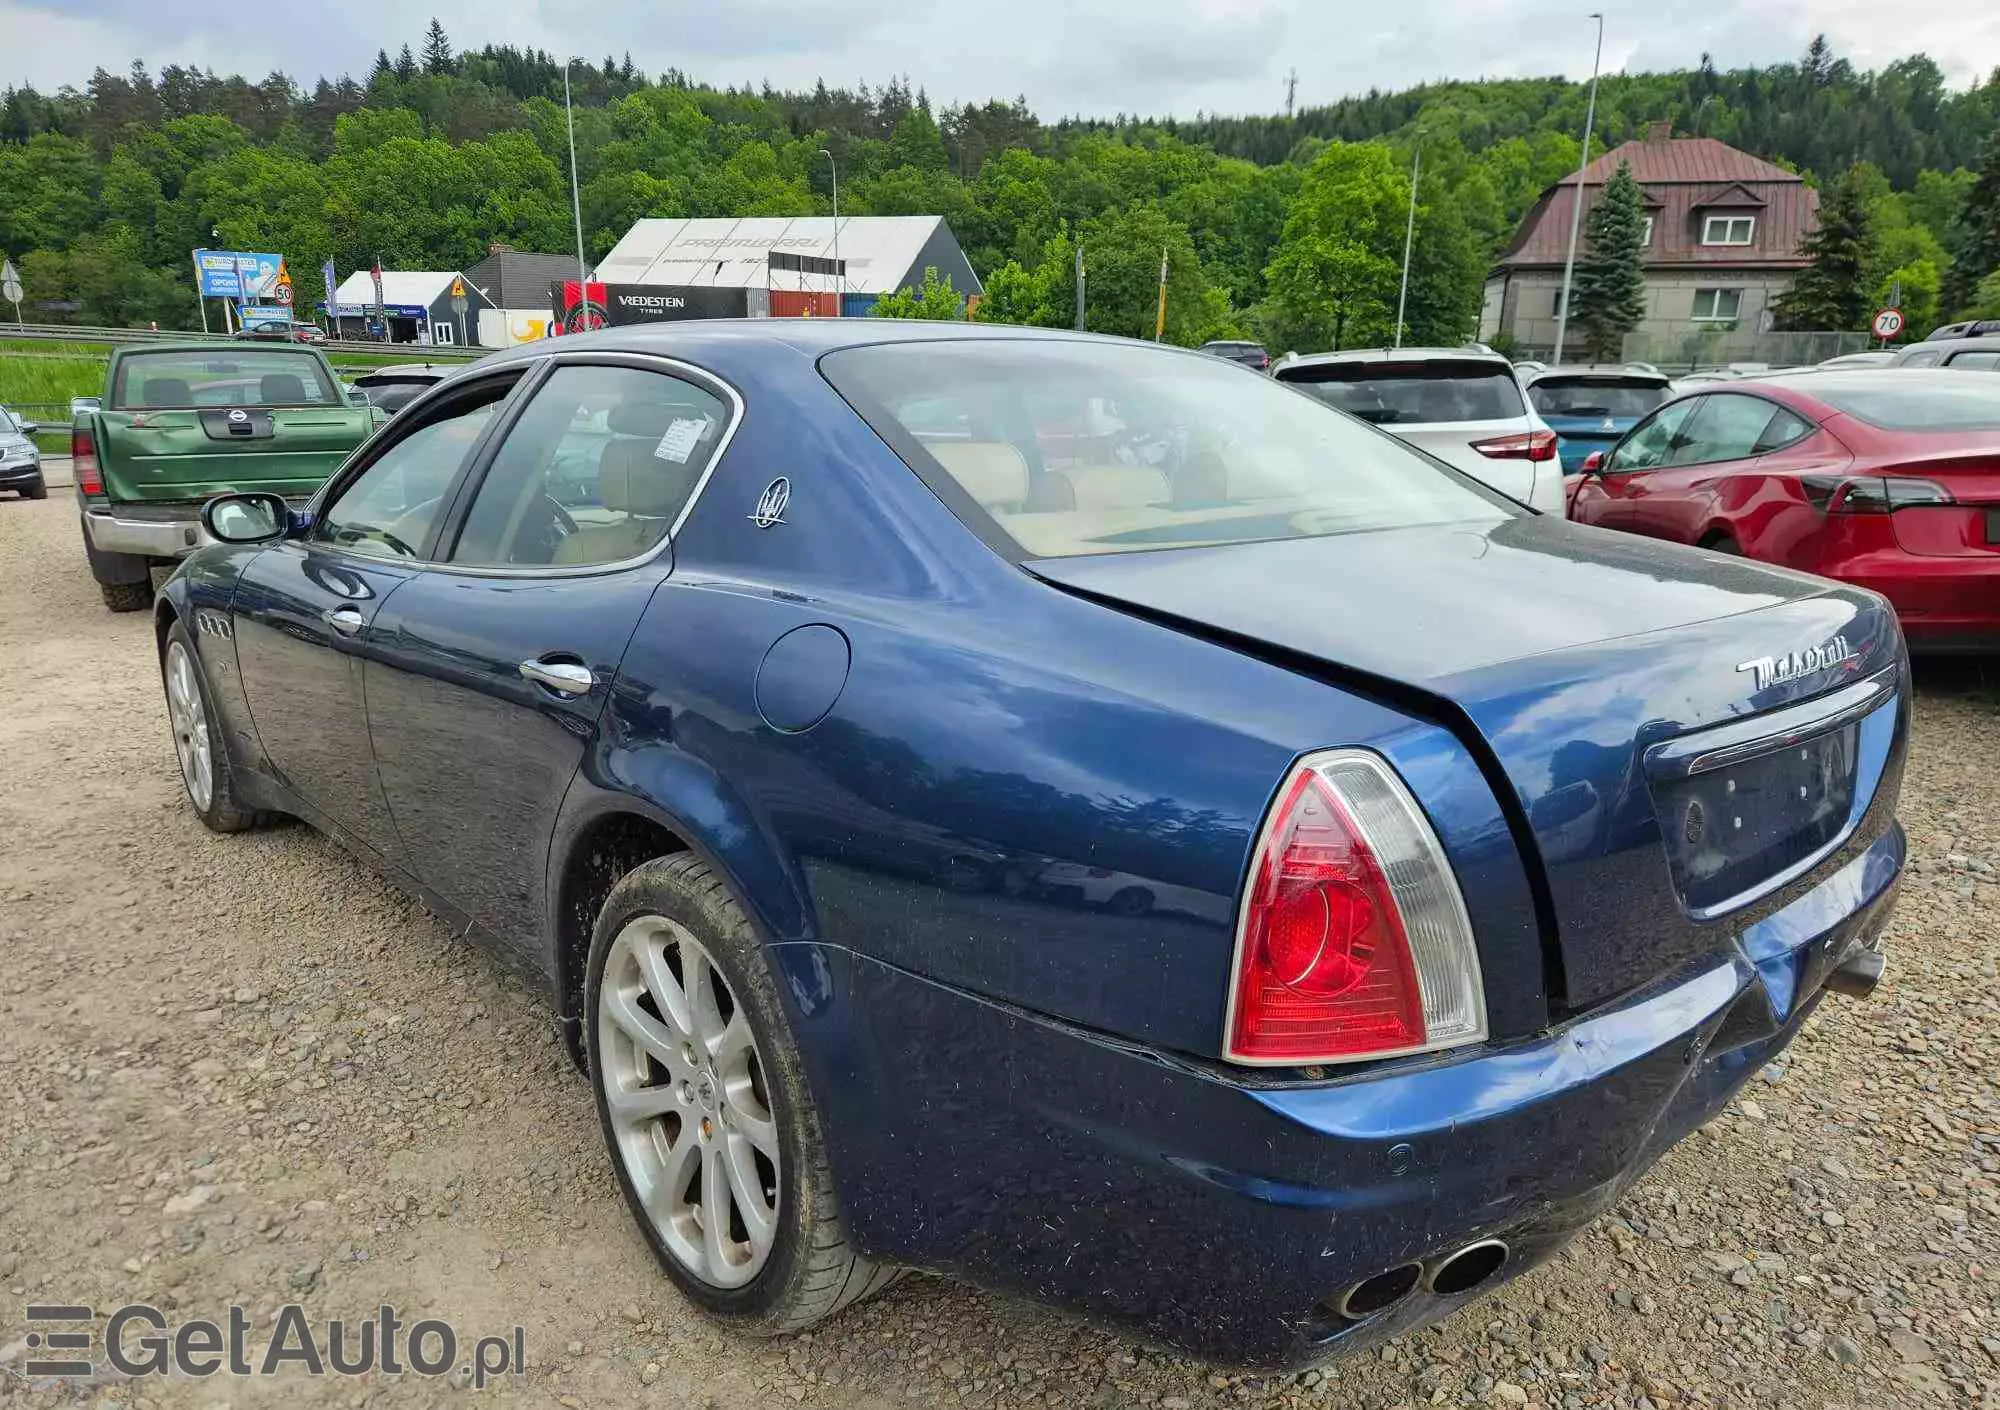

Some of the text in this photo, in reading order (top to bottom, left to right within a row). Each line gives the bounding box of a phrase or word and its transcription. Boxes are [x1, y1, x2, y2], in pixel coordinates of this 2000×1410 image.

[278, 288, 291, 300] 50
[618, 295, 685, 308] VREDESTEIN
[1880, 316, 1899, 330] 70
[1735, 635, 1860, 691] Maserati
